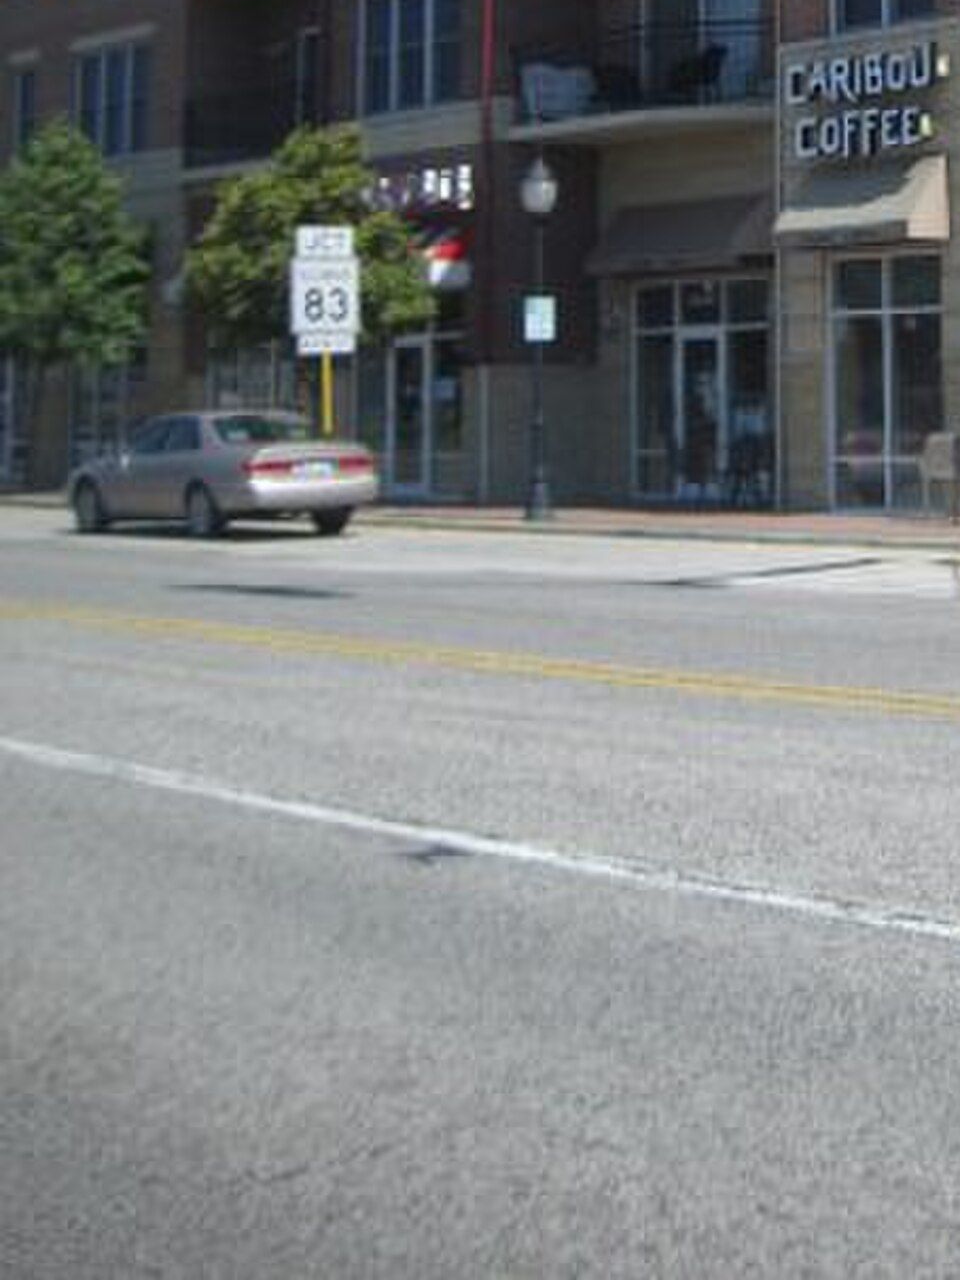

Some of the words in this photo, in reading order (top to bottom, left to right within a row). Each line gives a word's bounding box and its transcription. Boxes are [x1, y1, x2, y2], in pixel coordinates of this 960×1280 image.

[785, 42, 934, 103] CARIBOU
[795, 107, 921, 157] COFFEE
[304, 286, 349, 322] 83
